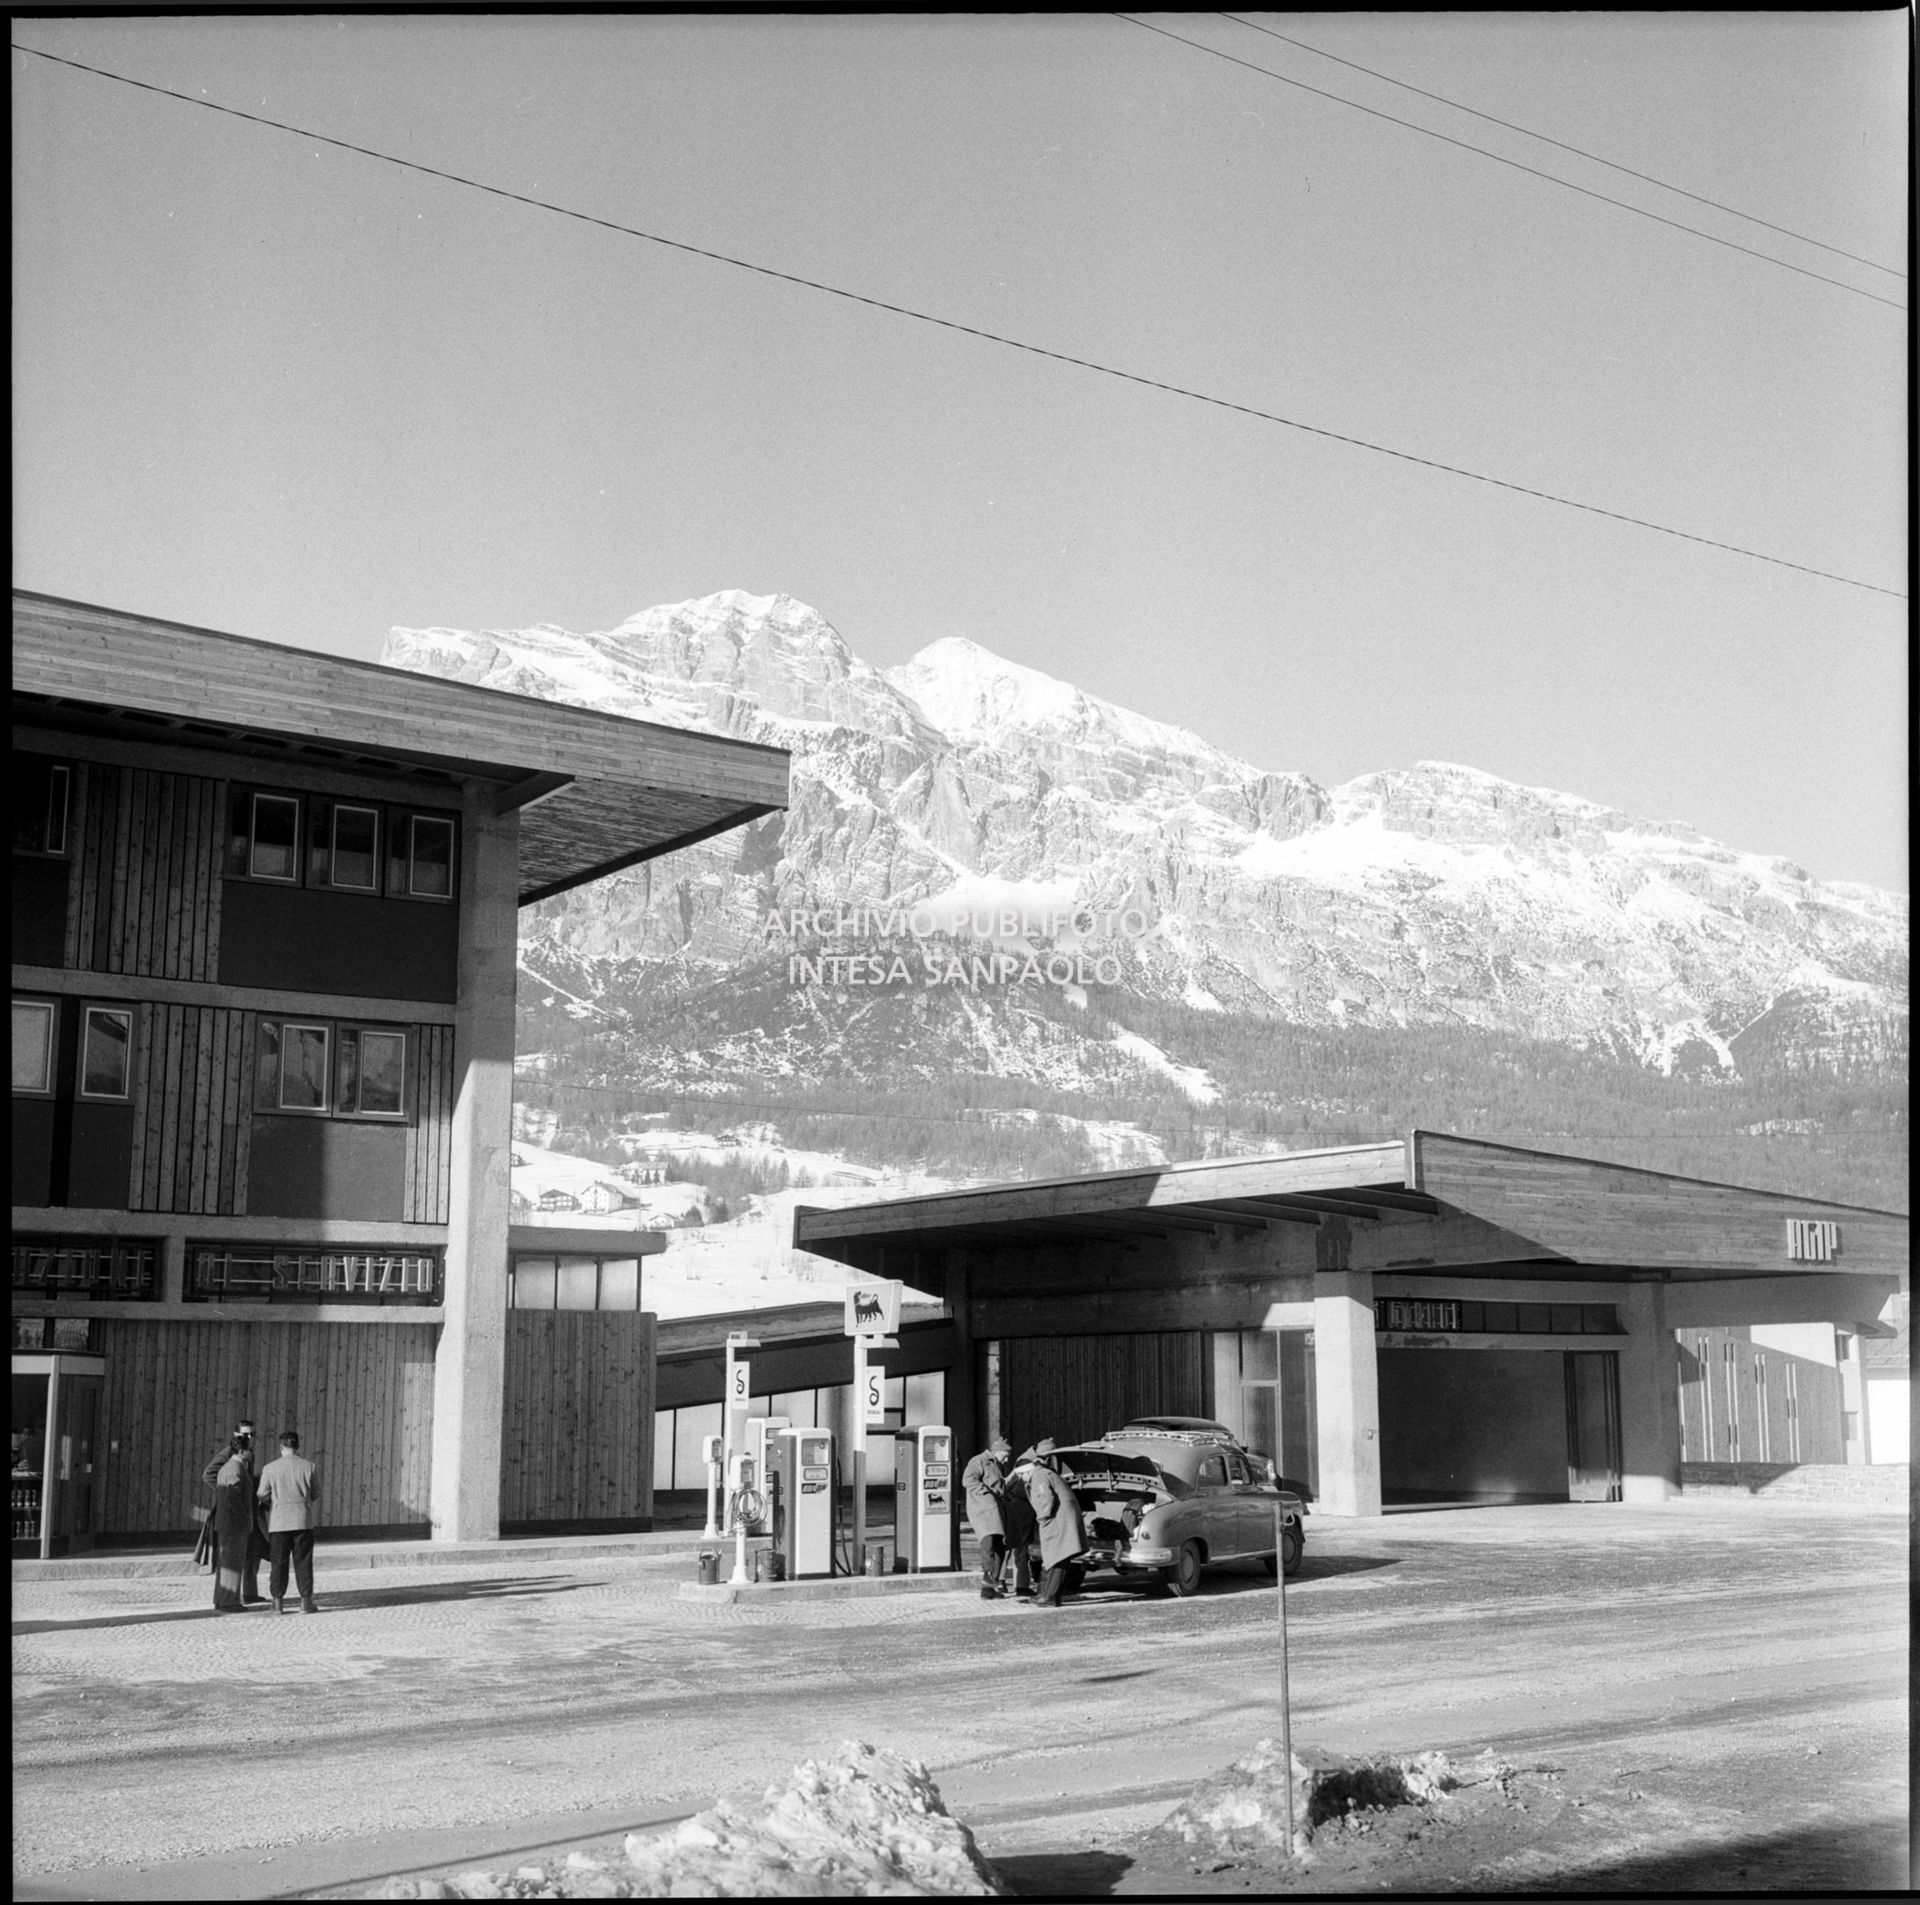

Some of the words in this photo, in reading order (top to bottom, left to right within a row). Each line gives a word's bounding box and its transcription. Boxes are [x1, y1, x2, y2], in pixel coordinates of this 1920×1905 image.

[1786, 1218, 1838, 1261] AGIP
[197, 1252, 232, 1289] DI
[272, 1254, 434, 1292] SERVIZIO
